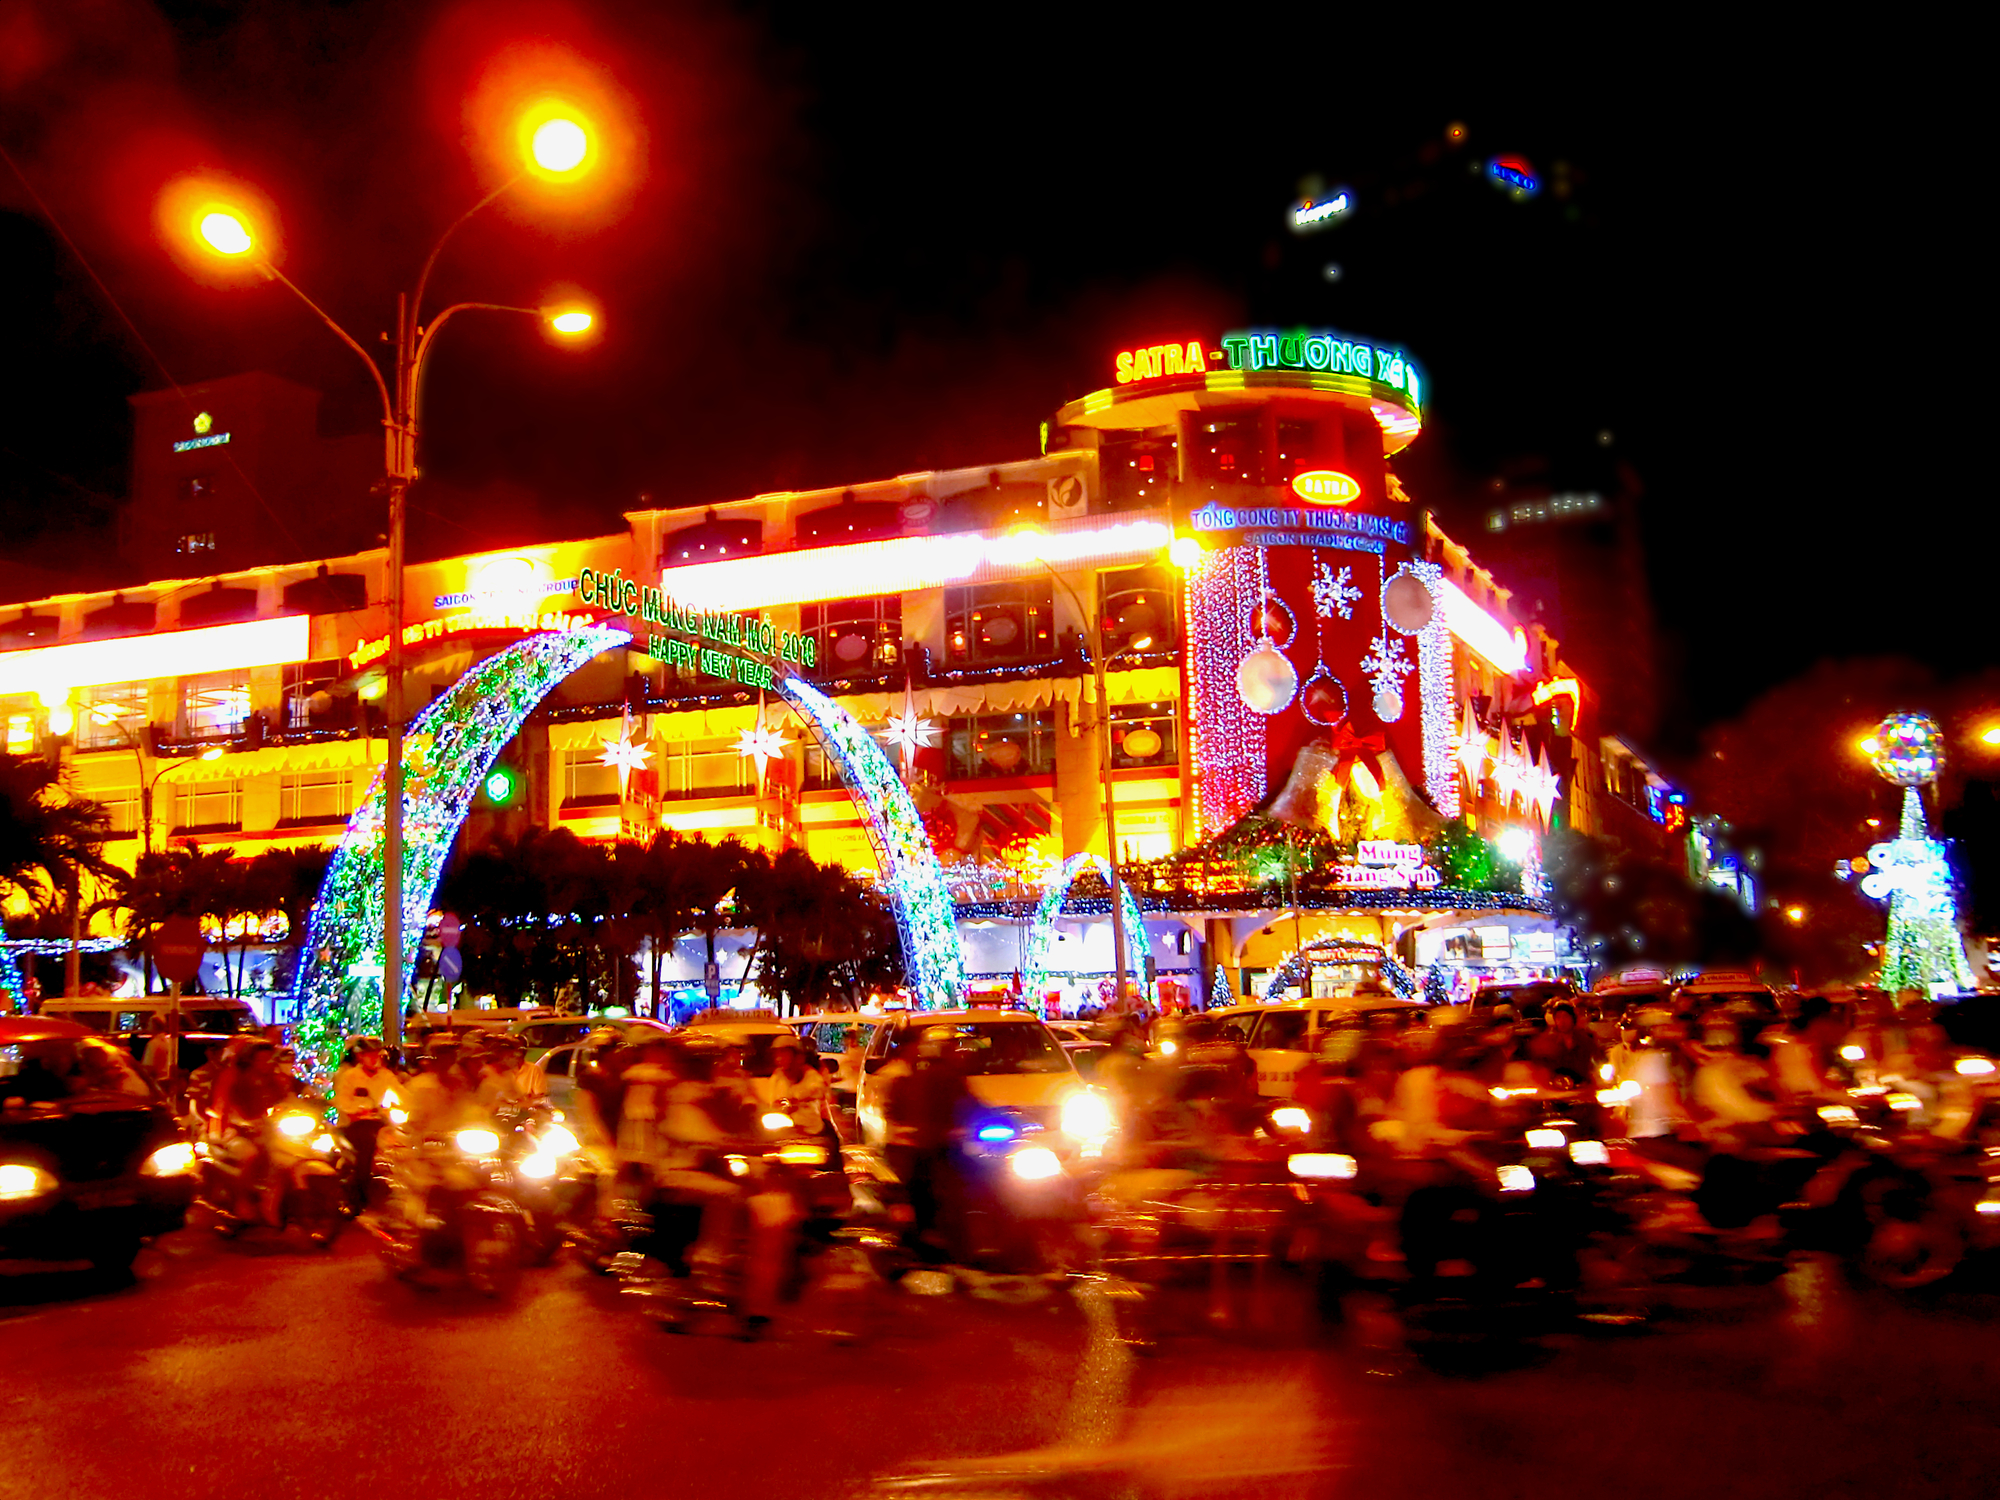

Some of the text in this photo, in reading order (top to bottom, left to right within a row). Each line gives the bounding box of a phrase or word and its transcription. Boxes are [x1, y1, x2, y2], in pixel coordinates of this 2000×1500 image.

[1116, 341, 1206, 384] SATRA
[580, 567, 638, 616] CHÚC
[780, 631, 816, 667] 2010
[648, 634, 773, 690] HAPPY NEW YEAR
